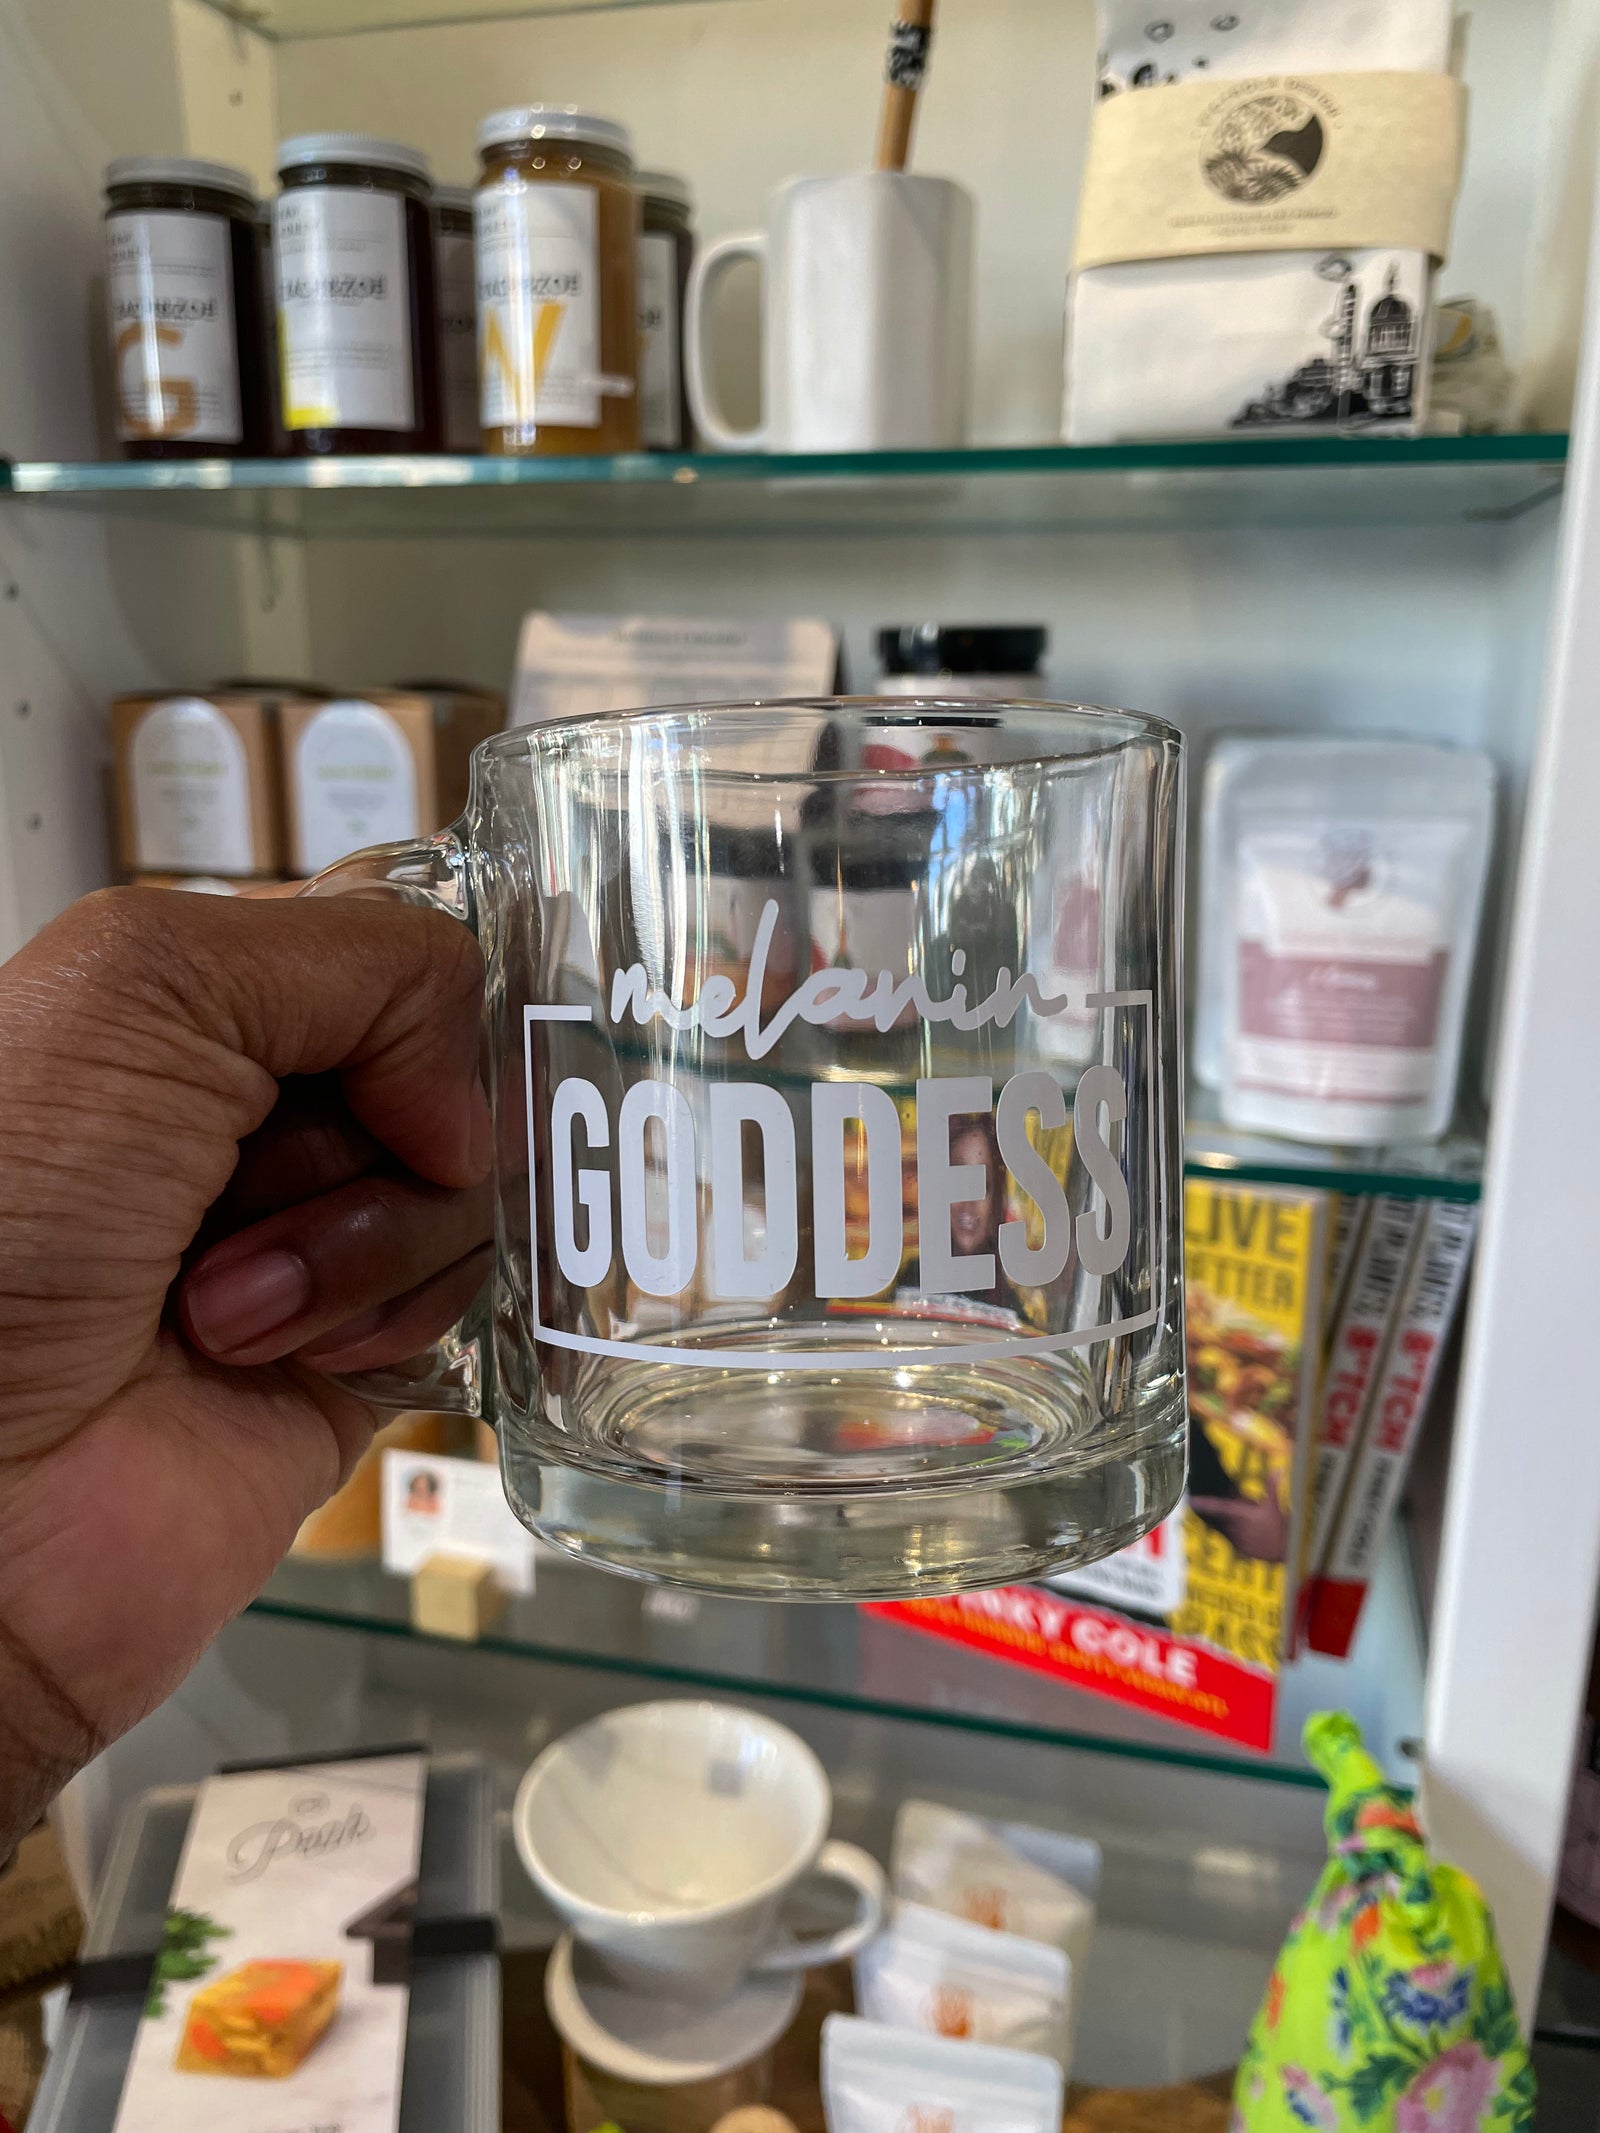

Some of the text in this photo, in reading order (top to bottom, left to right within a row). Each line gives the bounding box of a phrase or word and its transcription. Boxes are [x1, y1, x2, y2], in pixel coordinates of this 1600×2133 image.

[611, 899, 1067, 1059] melanin
[551, 1066, 1130, 1297] GODDESS
[1070, 1617, 1199, 1688] COLE
